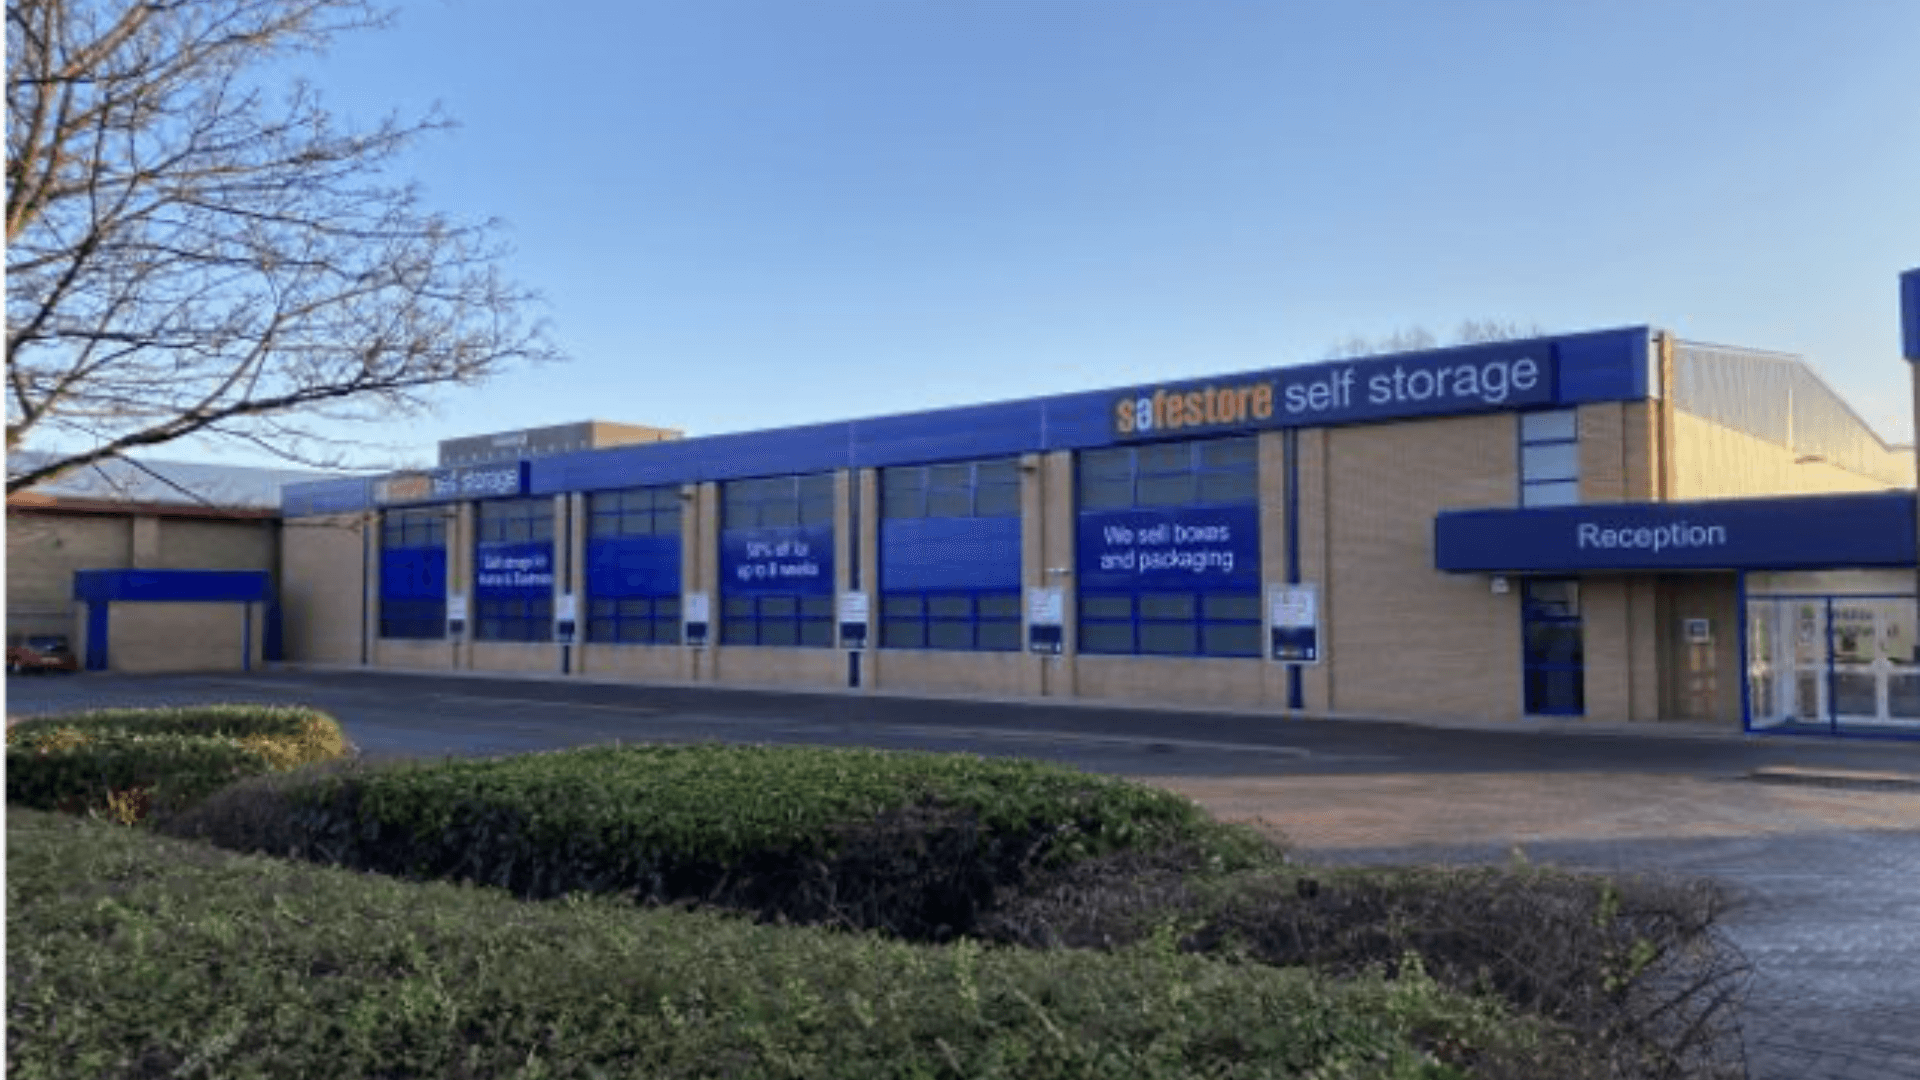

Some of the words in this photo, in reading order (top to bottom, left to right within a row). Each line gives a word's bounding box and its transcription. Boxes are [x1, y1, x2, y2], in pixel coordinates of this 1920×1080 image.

[1116, 382, 1273, 433] safestore
[1284, 366, 1355, 413] self
[1368, 356, 1539, 404] storage
[1103, 525, 1134, 545] We
[1138, 523, 1169, 545] sell
[1174, 523, 1231, 544] boxes
[1576, 521, 1727, 553] Reception
[1100, 549, 1135, 569] and
[1138, 548, 1234, 573] packaging
